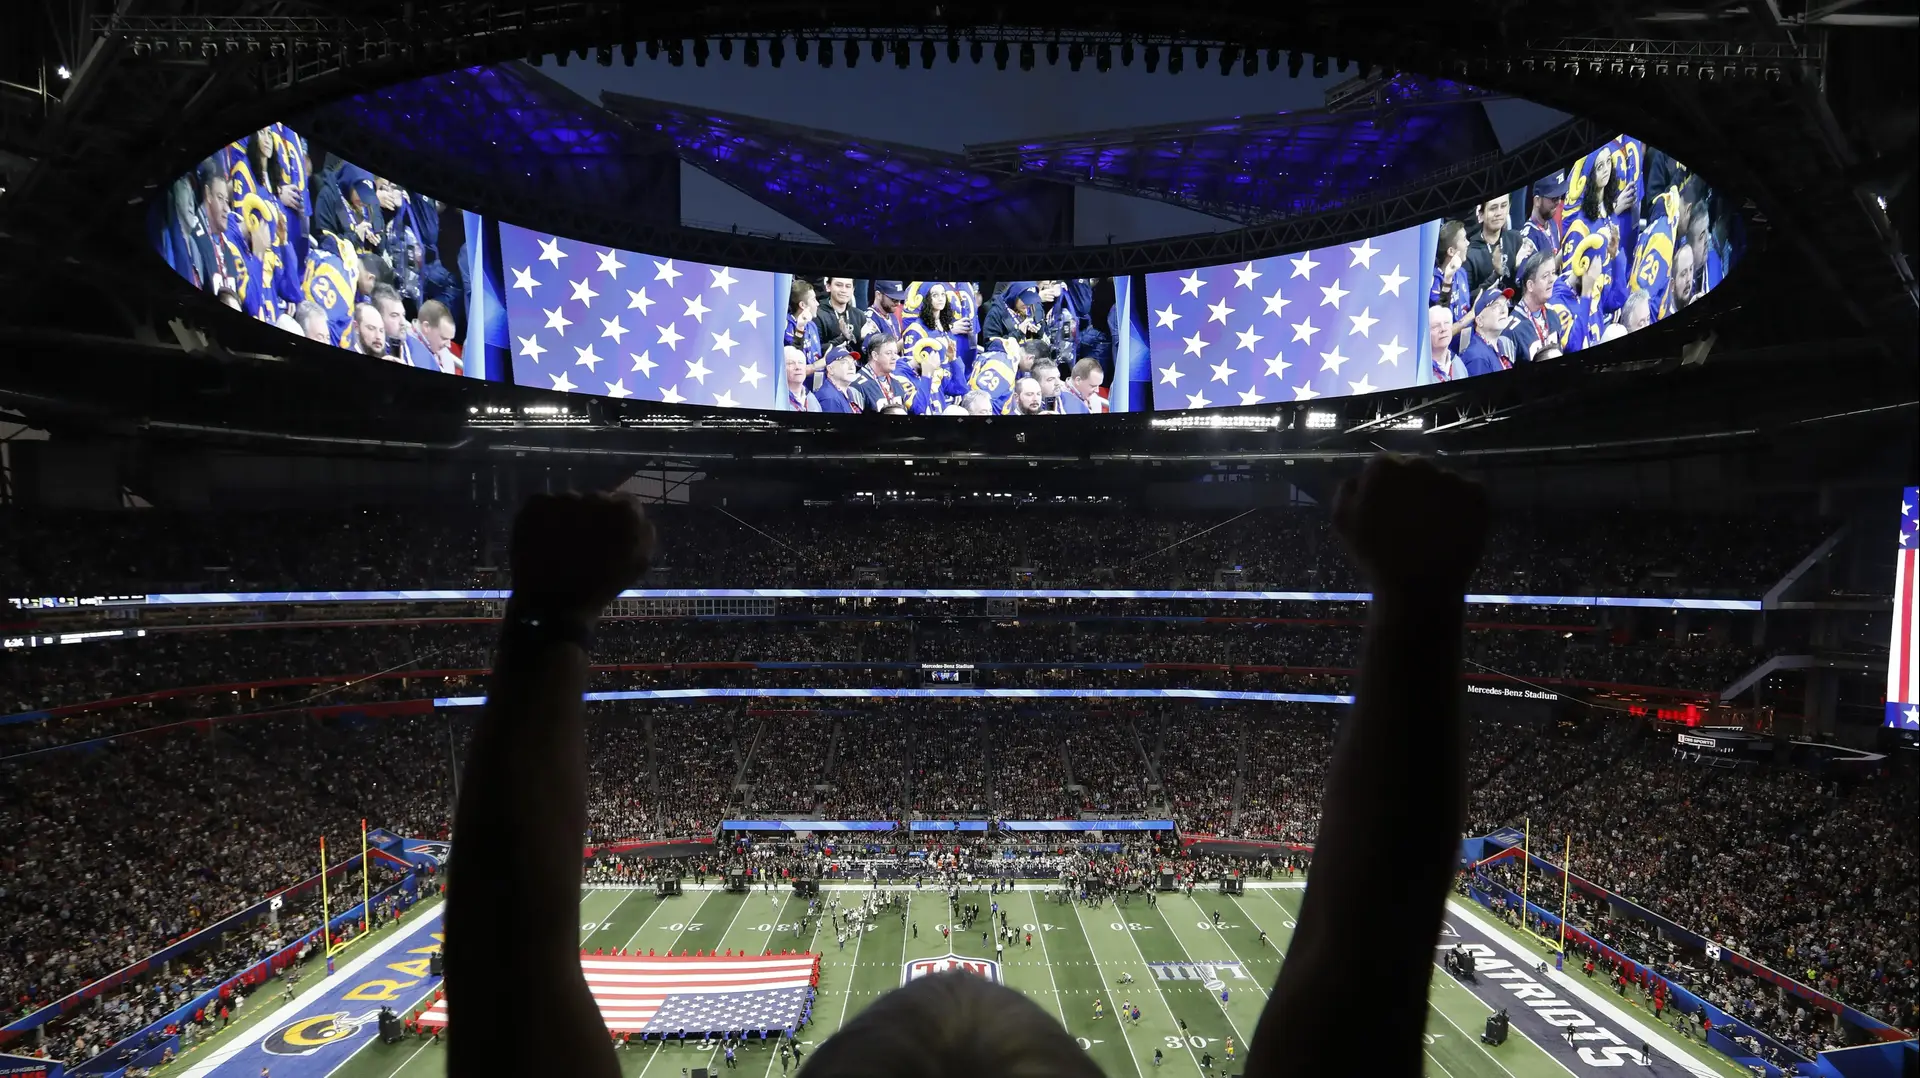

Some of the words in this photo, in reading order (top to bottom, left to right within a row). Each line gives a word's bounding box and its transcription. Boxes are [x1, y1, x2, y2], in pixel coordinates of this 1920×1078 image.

[1640, 254, 1659, 285] 29
[312, 277, 337, 309] 29
[980, 370, 1000, 391] 29
[1467, 685, 1523, 697] Mercedes-Benz
[1524, 690, 1558, 701] Stadium
[1706, 942, 1720, 956] 25
[1435, 943, 1652, 1067] PATRIOTS
[1164, 1035, 1207, 1049] 30
